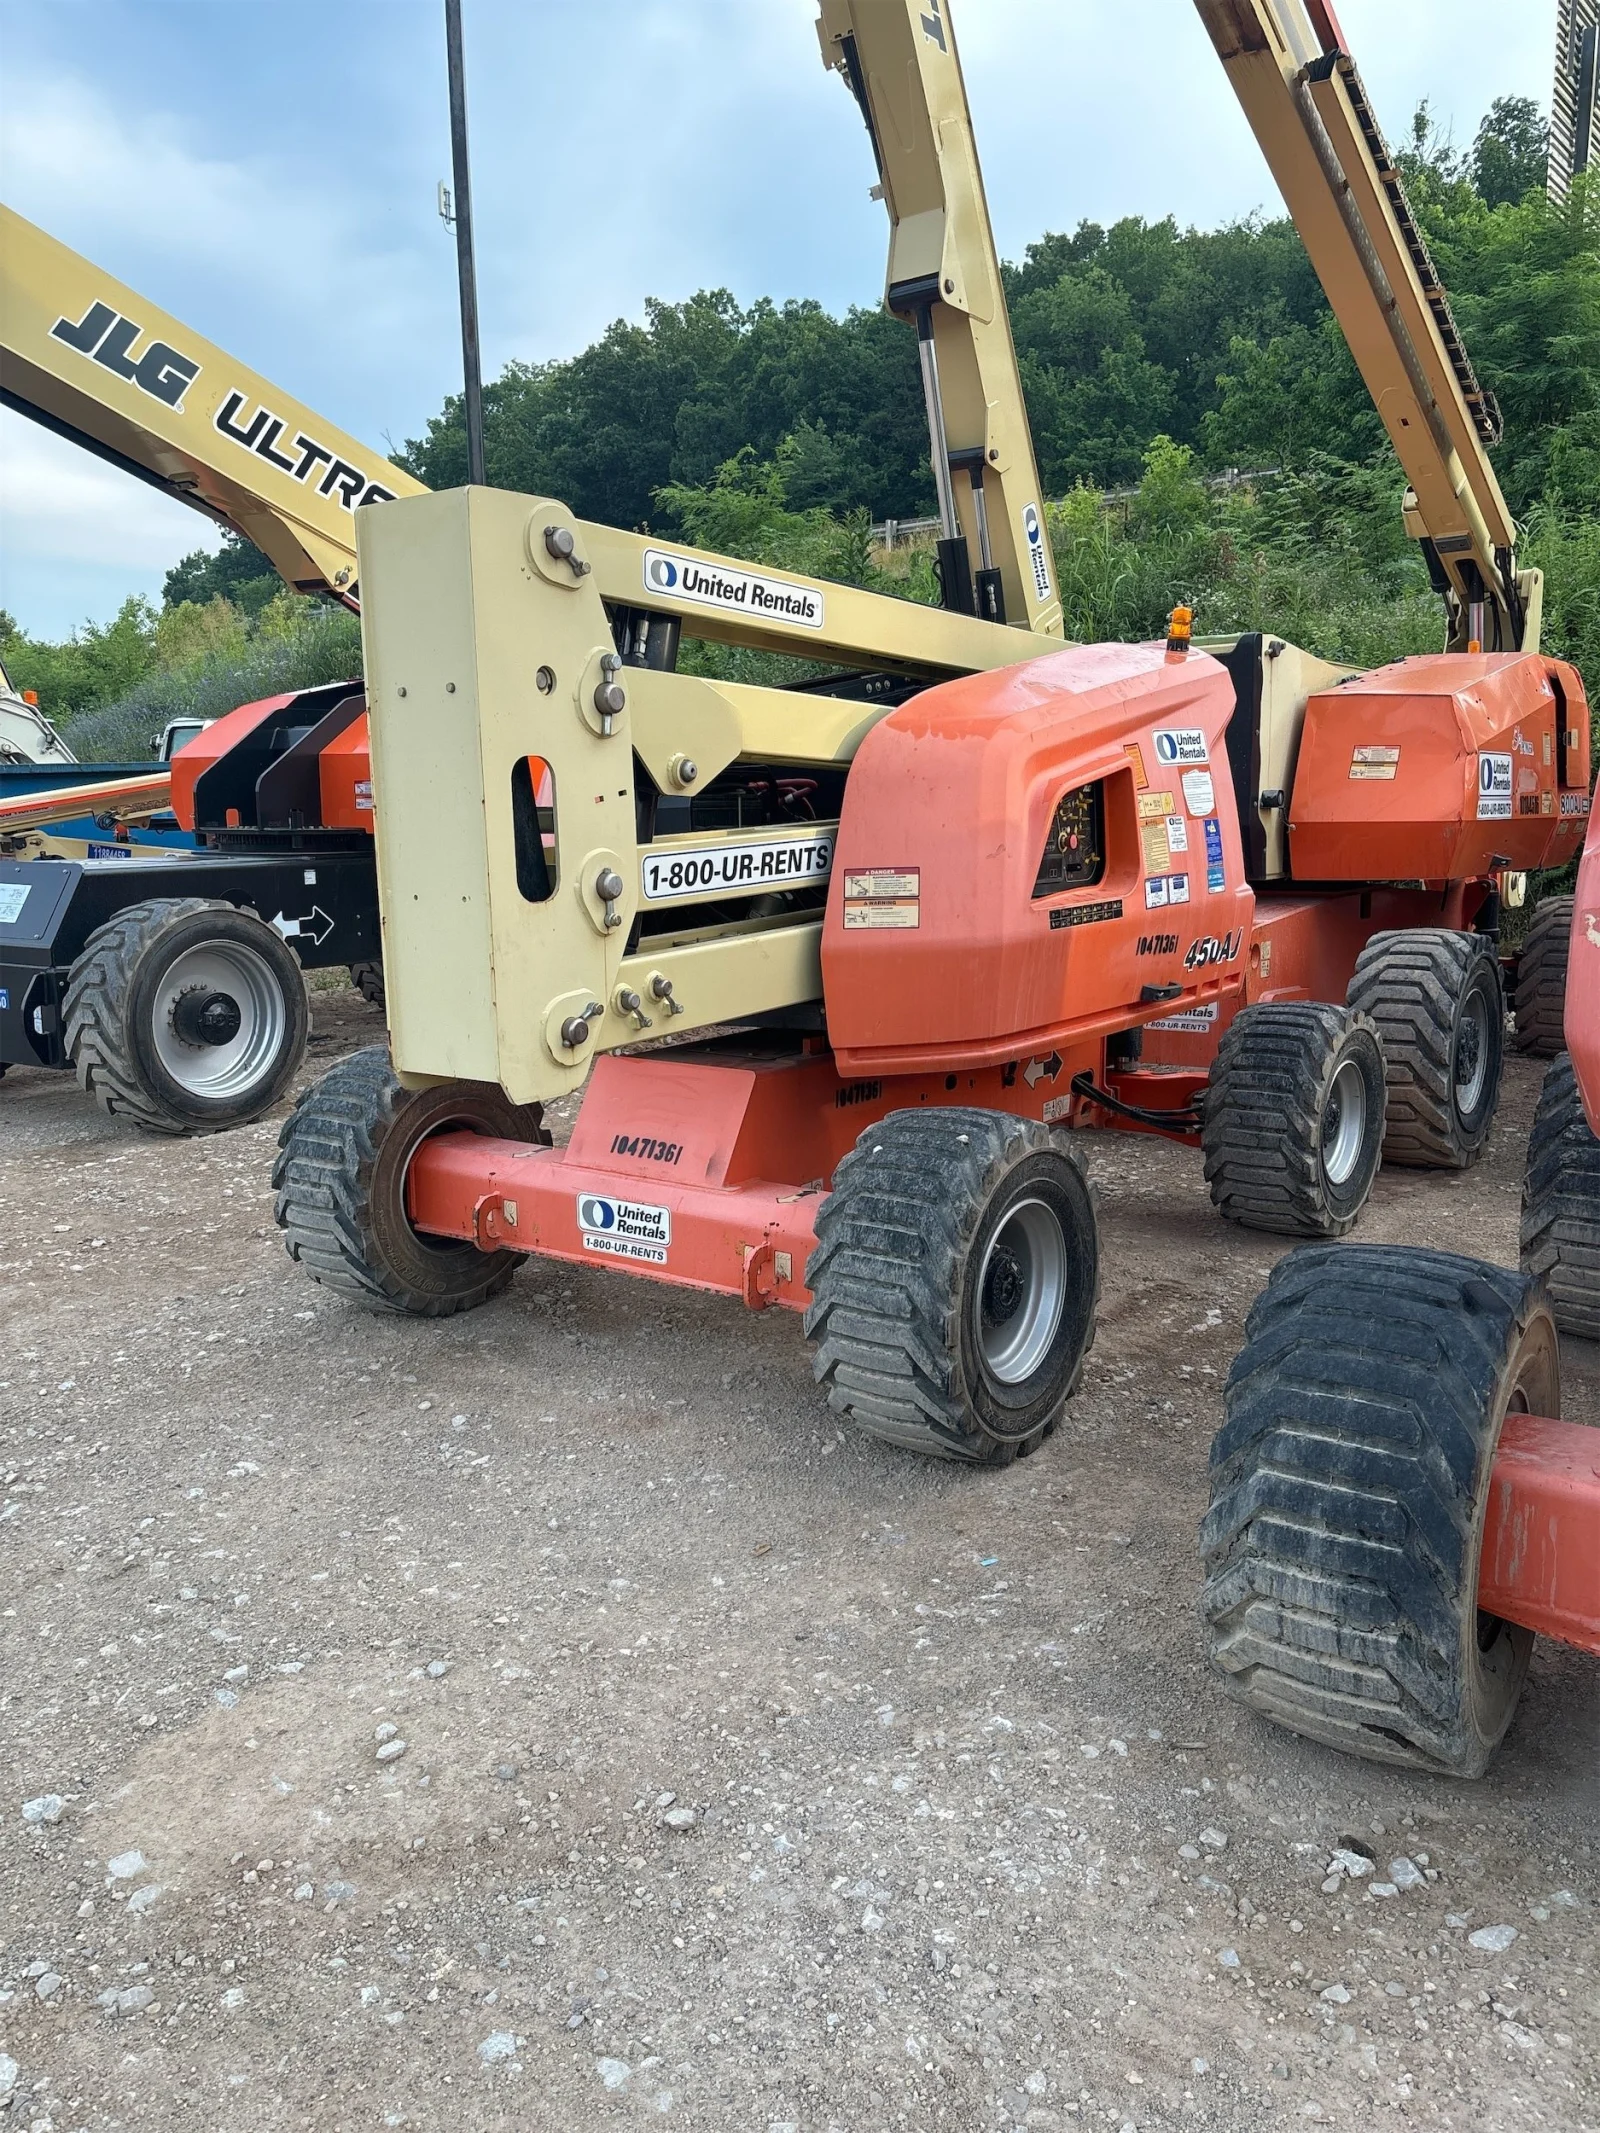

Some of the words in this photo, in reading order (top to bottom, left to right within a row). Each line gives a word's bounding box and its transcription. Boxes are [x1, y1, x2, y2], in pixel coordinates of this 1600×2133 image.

[50, 299, 202, 407] JLG
[1031, 549, 1044, 598] Rentals
[1036, 545, 1049, 590] United
[682, 567, 747, 603] United
[750, 584, 815, 618] Rentals
[1176, 733, 1201, 746] United
[1179, 747, 1206, 759] Rentals
[1493, 760, 1510, 774] United
[1492, 777, 1511, 791] Rentals
[648, 845, 829, 891] 1-800-UR-RENTS
[1136, 935, 1179, 955] 10471361
[1185, 927, 1242, 970] 450AJ
[836, 1080, 882, 1109] 10471361
[610, 1134, 683, 1166] 10471361
[617, 1204, 663, 1225] United
[616, 1219, 667, 1241] Rentals
[585, 1236, 664, 1262] 1-800-UR-RENTS
